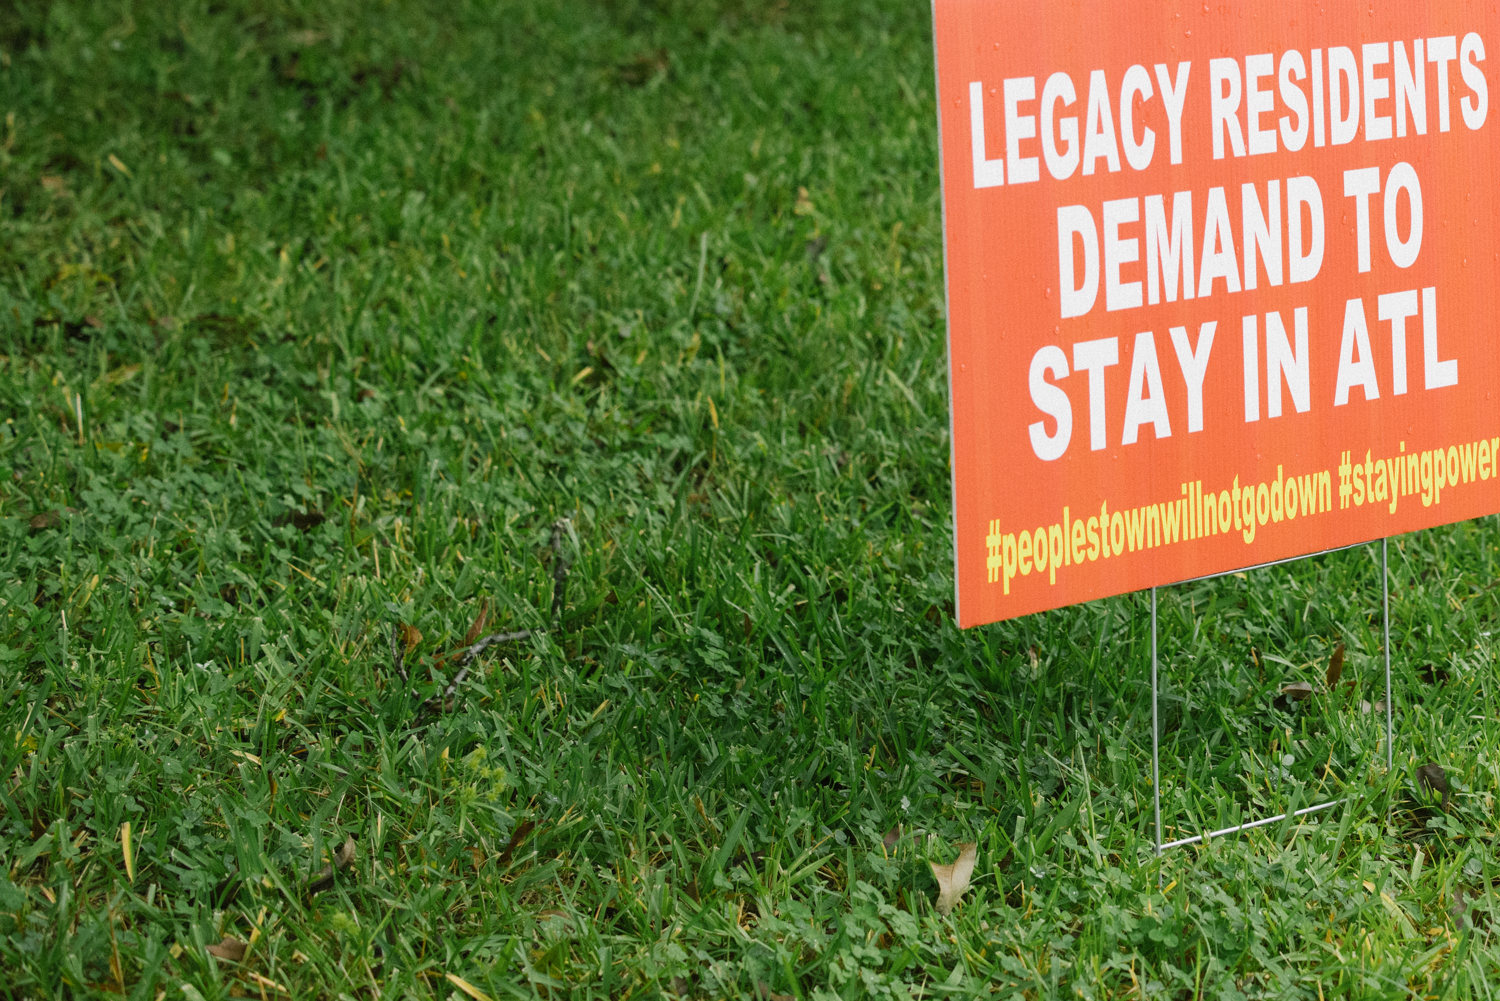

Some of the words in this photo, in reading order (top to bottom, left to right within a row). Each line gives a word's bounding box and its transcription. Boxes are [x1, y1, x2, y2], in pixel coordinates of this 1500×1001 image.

[969, 61, 1192, 190] LEGACY
[1209, 31, 1489, 160] RESIDENTS
[1057, 176, 1326, 320] DEMAND
[1343, 162, 1424, 274] TO
[1028, 321, 1218, 462] STAY
[1242, 306, 1311, 423] IN
[1334, 286, 1459, 407] ATL
[985, 464, 1333, 596] #peoplestownwillnotgodown
[1338, 436, 1500, 514] #stayingpower
